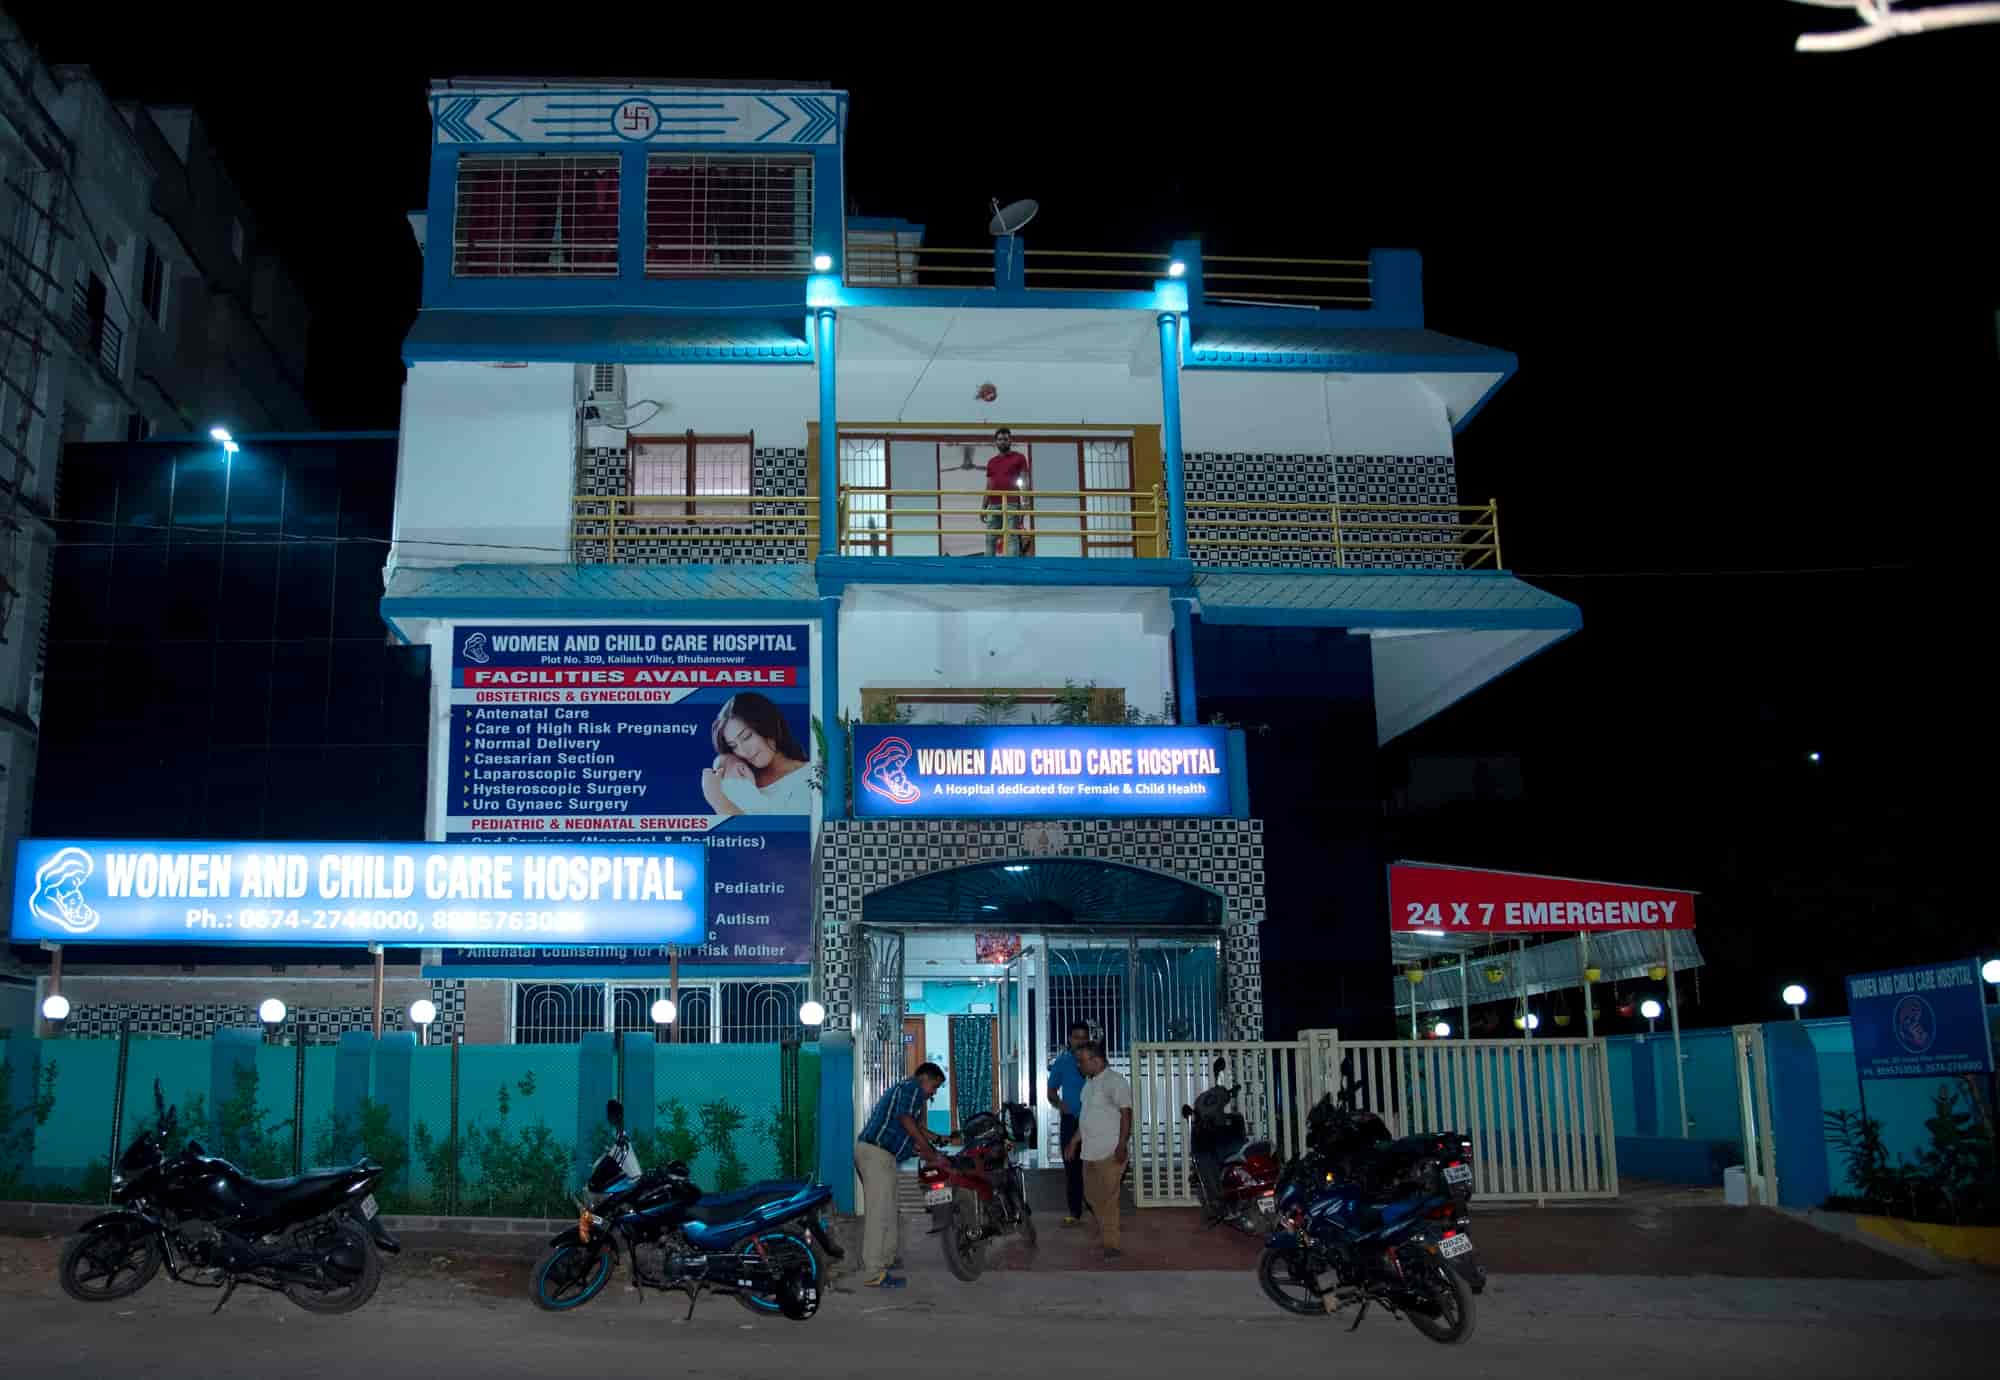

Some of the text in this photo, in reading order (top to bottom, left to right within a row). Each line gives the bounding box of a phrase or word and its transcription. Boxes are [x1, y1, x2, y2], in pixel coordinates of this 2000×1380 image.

[491, 634, 797, 652] WOMEN AND CHILD CARE HOSPITAL
[541, 654, 745, 667] Plot No. 309, Kailash Vihar, Bhubaneswar
[474, 670, 786, 684] FACILITIES AVAILABLE
[475, 690, 671, 703] OBSTETRICS & GYNECOLOGY
[475, 708, 590, 719] Antenatal Care
[475, 722, 698, 736] Care of High Risk Pregnancy
[474, 738, 601, 752] Normal Delivery
[473, 753, 615, 764] Caesarian Section
[917, 749, 1220, 776] WOMEN AND CHILD CARE HOSPITAL
[473, 768, 642, 782] Laparoscopic Surgery
[472, 783, 647, 798] Hysteroscopic Surgery
[934, 782, 1206, 798] A Hospital dedicated for Female & Child Health
[472, 799, 628, 814] Uro Gynaec Surgery
[471, 818, 709, 830] PEDIATRIC & NEONATAL SERVICES
[105, 854, 683, 901] WOMEN AND CHILD CARE HOSPITAL
[714, 881, 785, 894] Pediatric
[186, 908, 232, 928] Ph.:
[715, 913, 770, 925] Autism
[1407, 901, 1677, 925] 24 X 7 EMERGENCY
[467, 947, 536, 958] Antenatal
[733, 944, 786, 957] Mother
